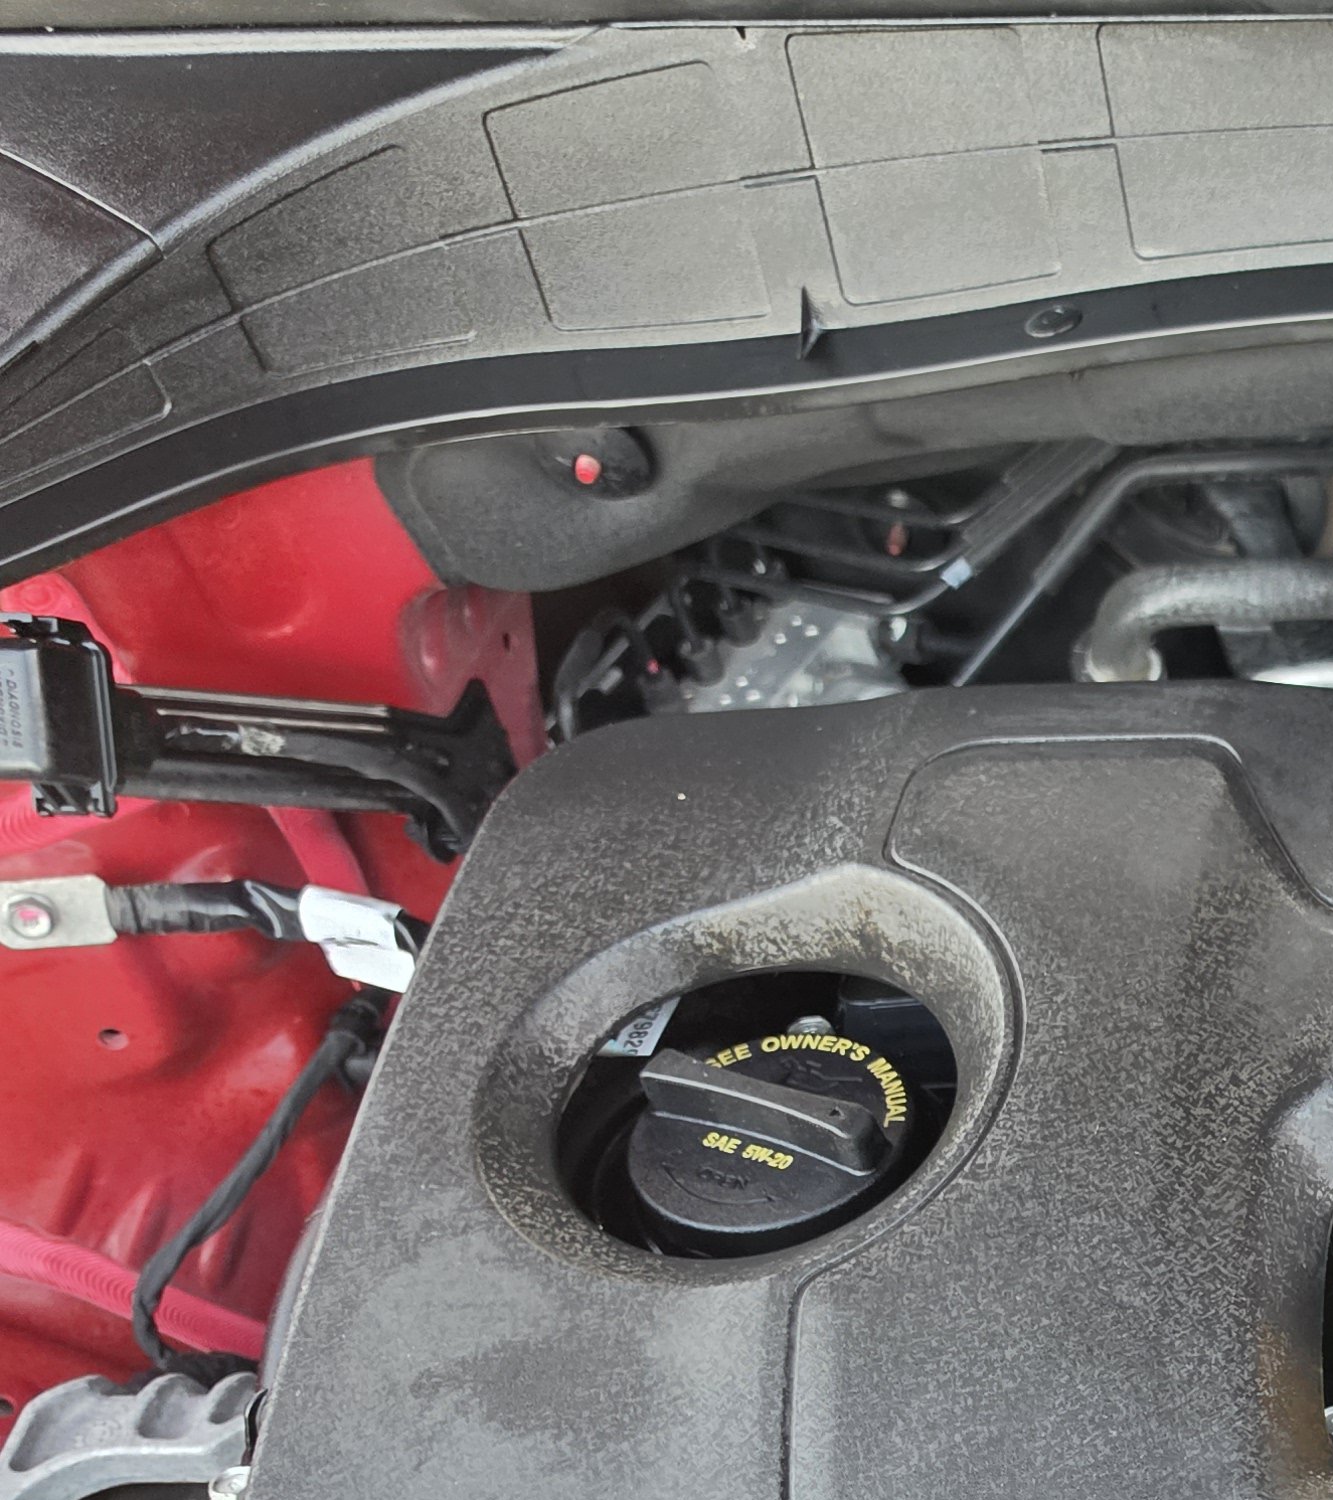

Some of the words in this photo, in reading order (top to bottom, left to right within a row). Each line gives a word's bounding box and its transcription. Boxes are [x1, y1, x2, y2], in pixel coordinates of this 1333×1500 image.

[761, 1034, 871, 1062] OWNER'S
[866, 1057, 908, 1129] MANUAL
[702, 1131, 742, 1154] SAE
[742, 1144, 795, 1170] 5W-20
